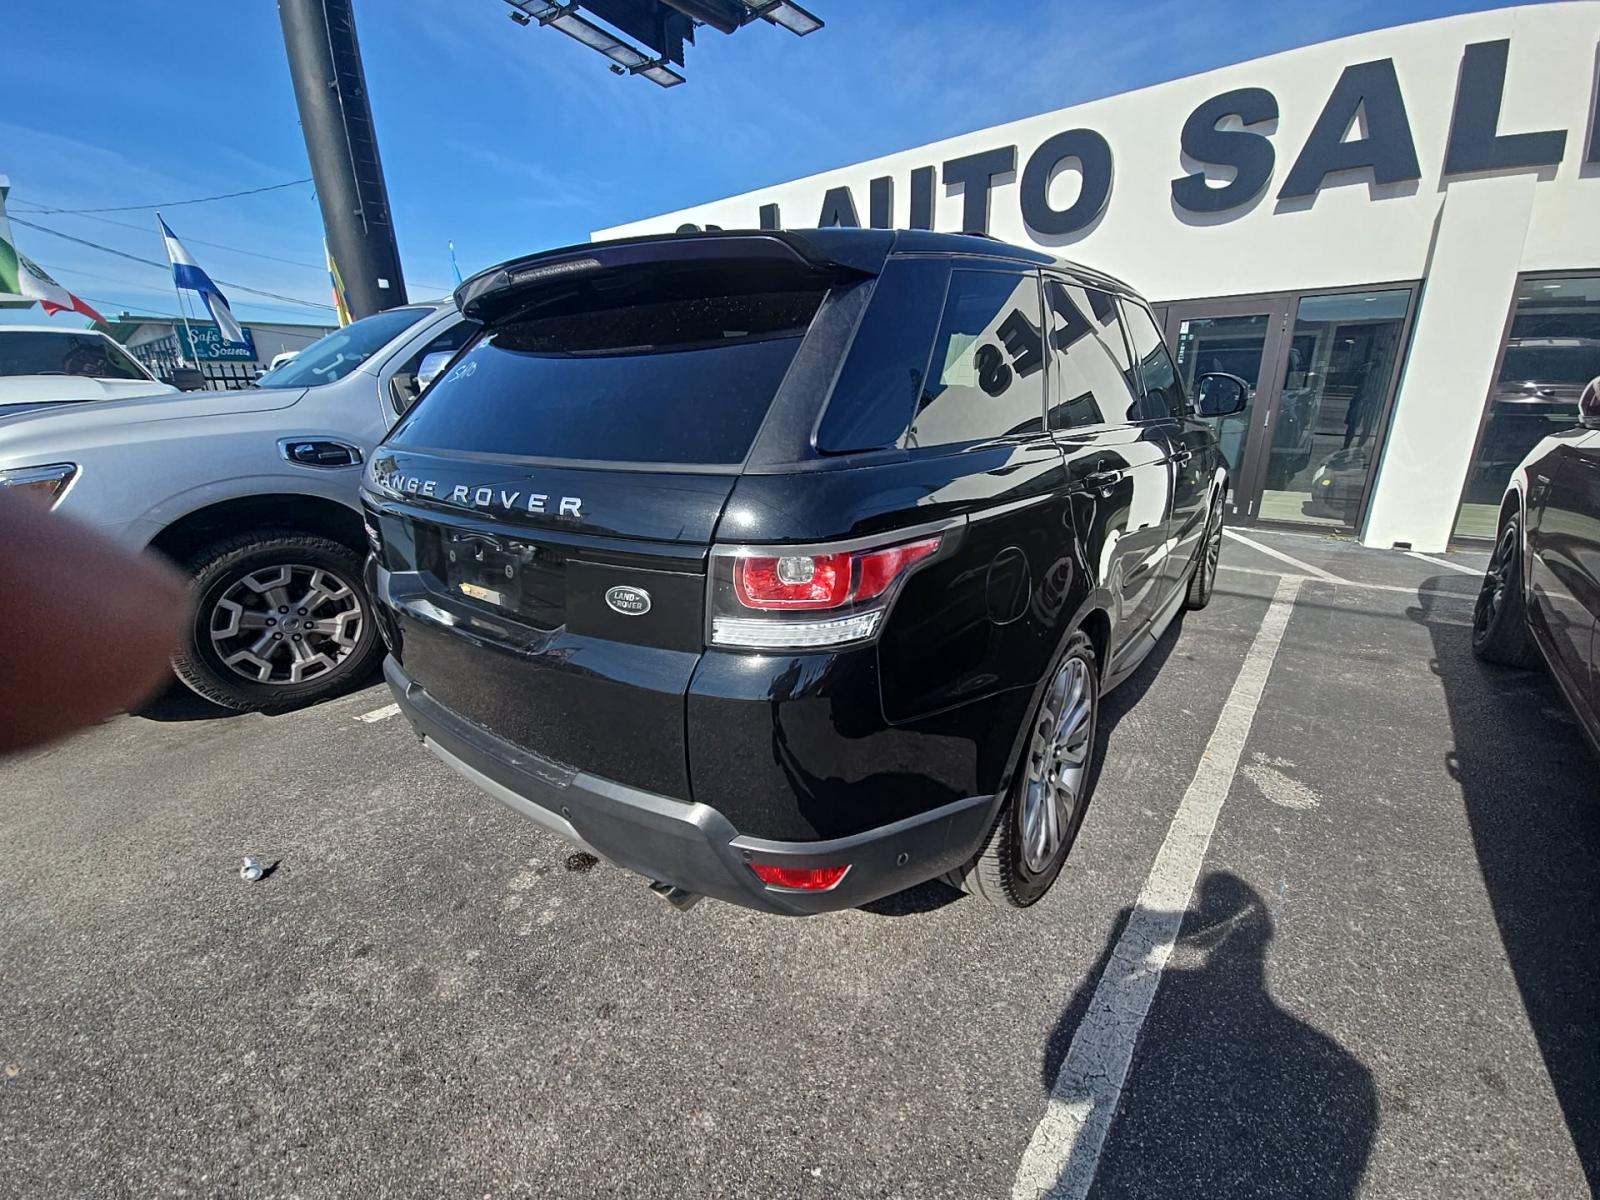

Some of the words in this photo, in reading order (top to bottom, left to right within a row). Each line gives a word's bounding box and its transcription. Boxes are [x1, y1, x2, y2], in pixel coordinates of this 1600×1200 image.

[818, 128, 1112, 236] AUTO
[1171, 38, 1600, 213] SAL
[187, 328, 220, 344] Safe
[453, 484, 584, 518] ROVER
[613, 591, 635, 601] LAND
[616, 600, 643, 610] ROVER
